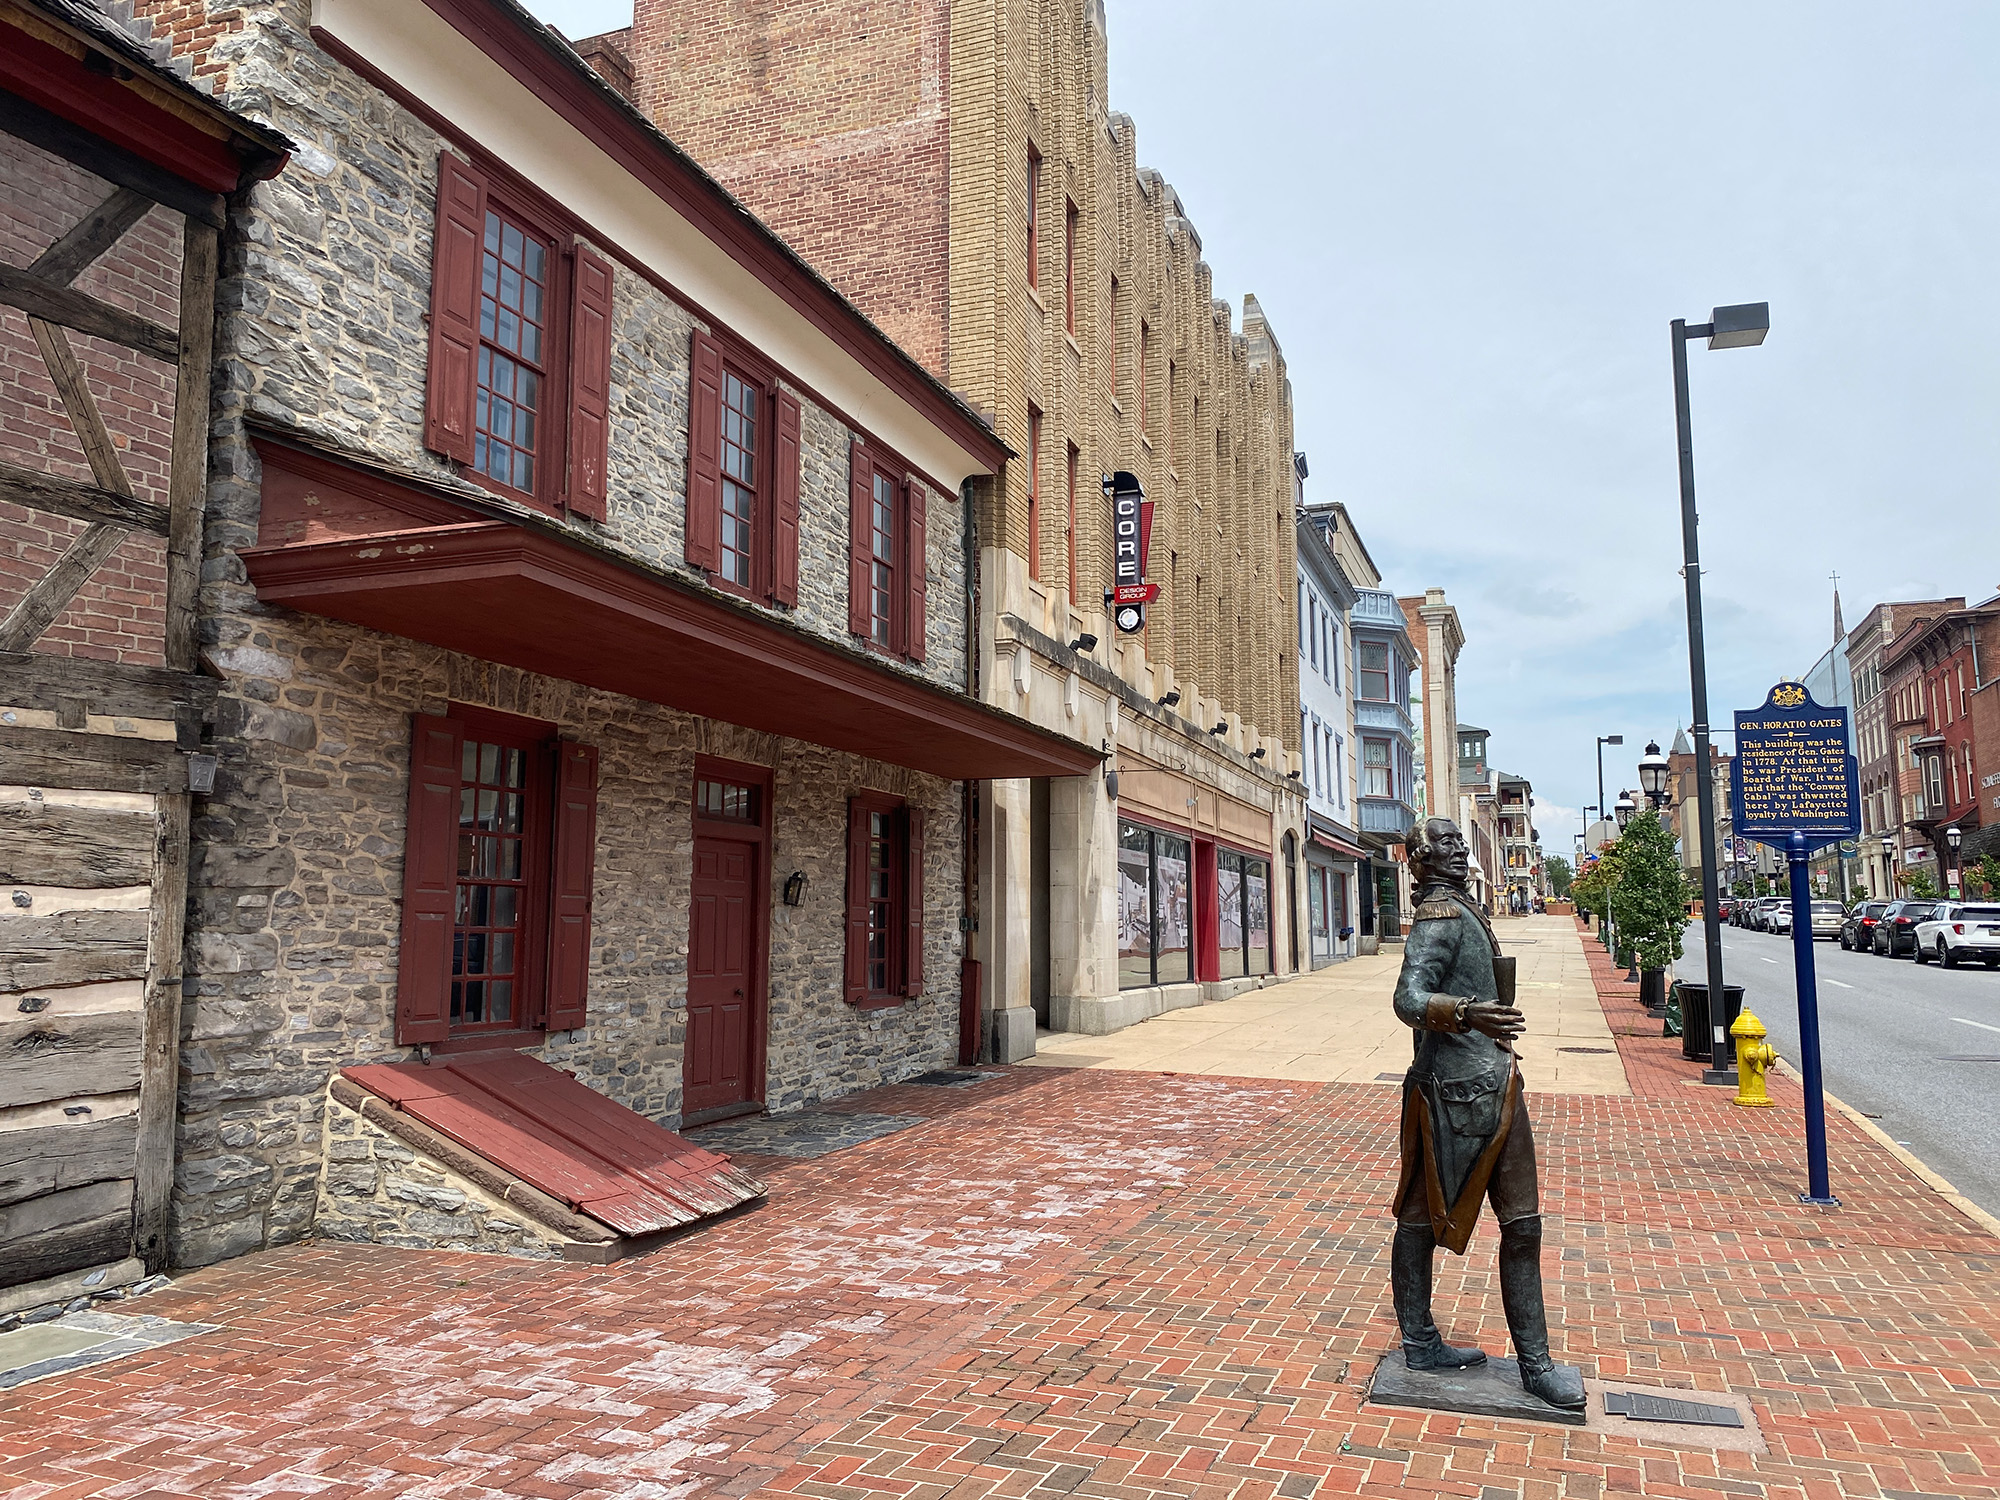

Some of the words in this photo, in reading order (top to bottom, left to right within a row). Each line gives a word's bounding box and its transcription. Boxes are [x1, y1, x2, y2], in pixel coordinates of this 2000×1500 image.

[1118, 501, 1136, 577] CORE
[1740, 722, 1761, 730] GEN.
[1763, 720, 1806, 729] HORATIO
[1809, 719, 1842, 728] GATES
[1742, 740, 1761, 749] This
[1765, 739, 1804, 748] building
[1826, 738, 1842, 746] the
[1742, 749, 1785, 757] residence
[1798, 748, 1818, 756] Gen.
[1820, 747, 1845, 755] Gates
[1743, 758, 1752, 766] in
[1755, 758, 1778, 766] 1778.
[1782, 757, 1794, 765] At
[1798, 757, 1818, 765] that
[1822, 756, 1844, 764] time
[1743, 767, 1755, 775] he
[1780, 765, 1827, 774] President
[1832, 764, 1844, 772] of
[1743, 775, 1771, 783] Board
[1775, 775, 1786, 783] of
[1790, 774, 1811, 782] War.
[1743, 783, 1763, 792] said
[1766, 783, 1785, 791] that
[1788, 783, 1804, 791] the
[1805, 782, 1847, 792] "Conway
[1743, 792, 1777, 801] Cabal"
[1800, 791, 1848, 799] thwarted
[1745, 801, 1769, 809] here
[1774, 801, 1788, 811] by
[1792, 800, 1848, 811] Lafayette's
[1745, 810, 1777, 820] loyalty
[1791, 809, 1849, 819] Washington.
